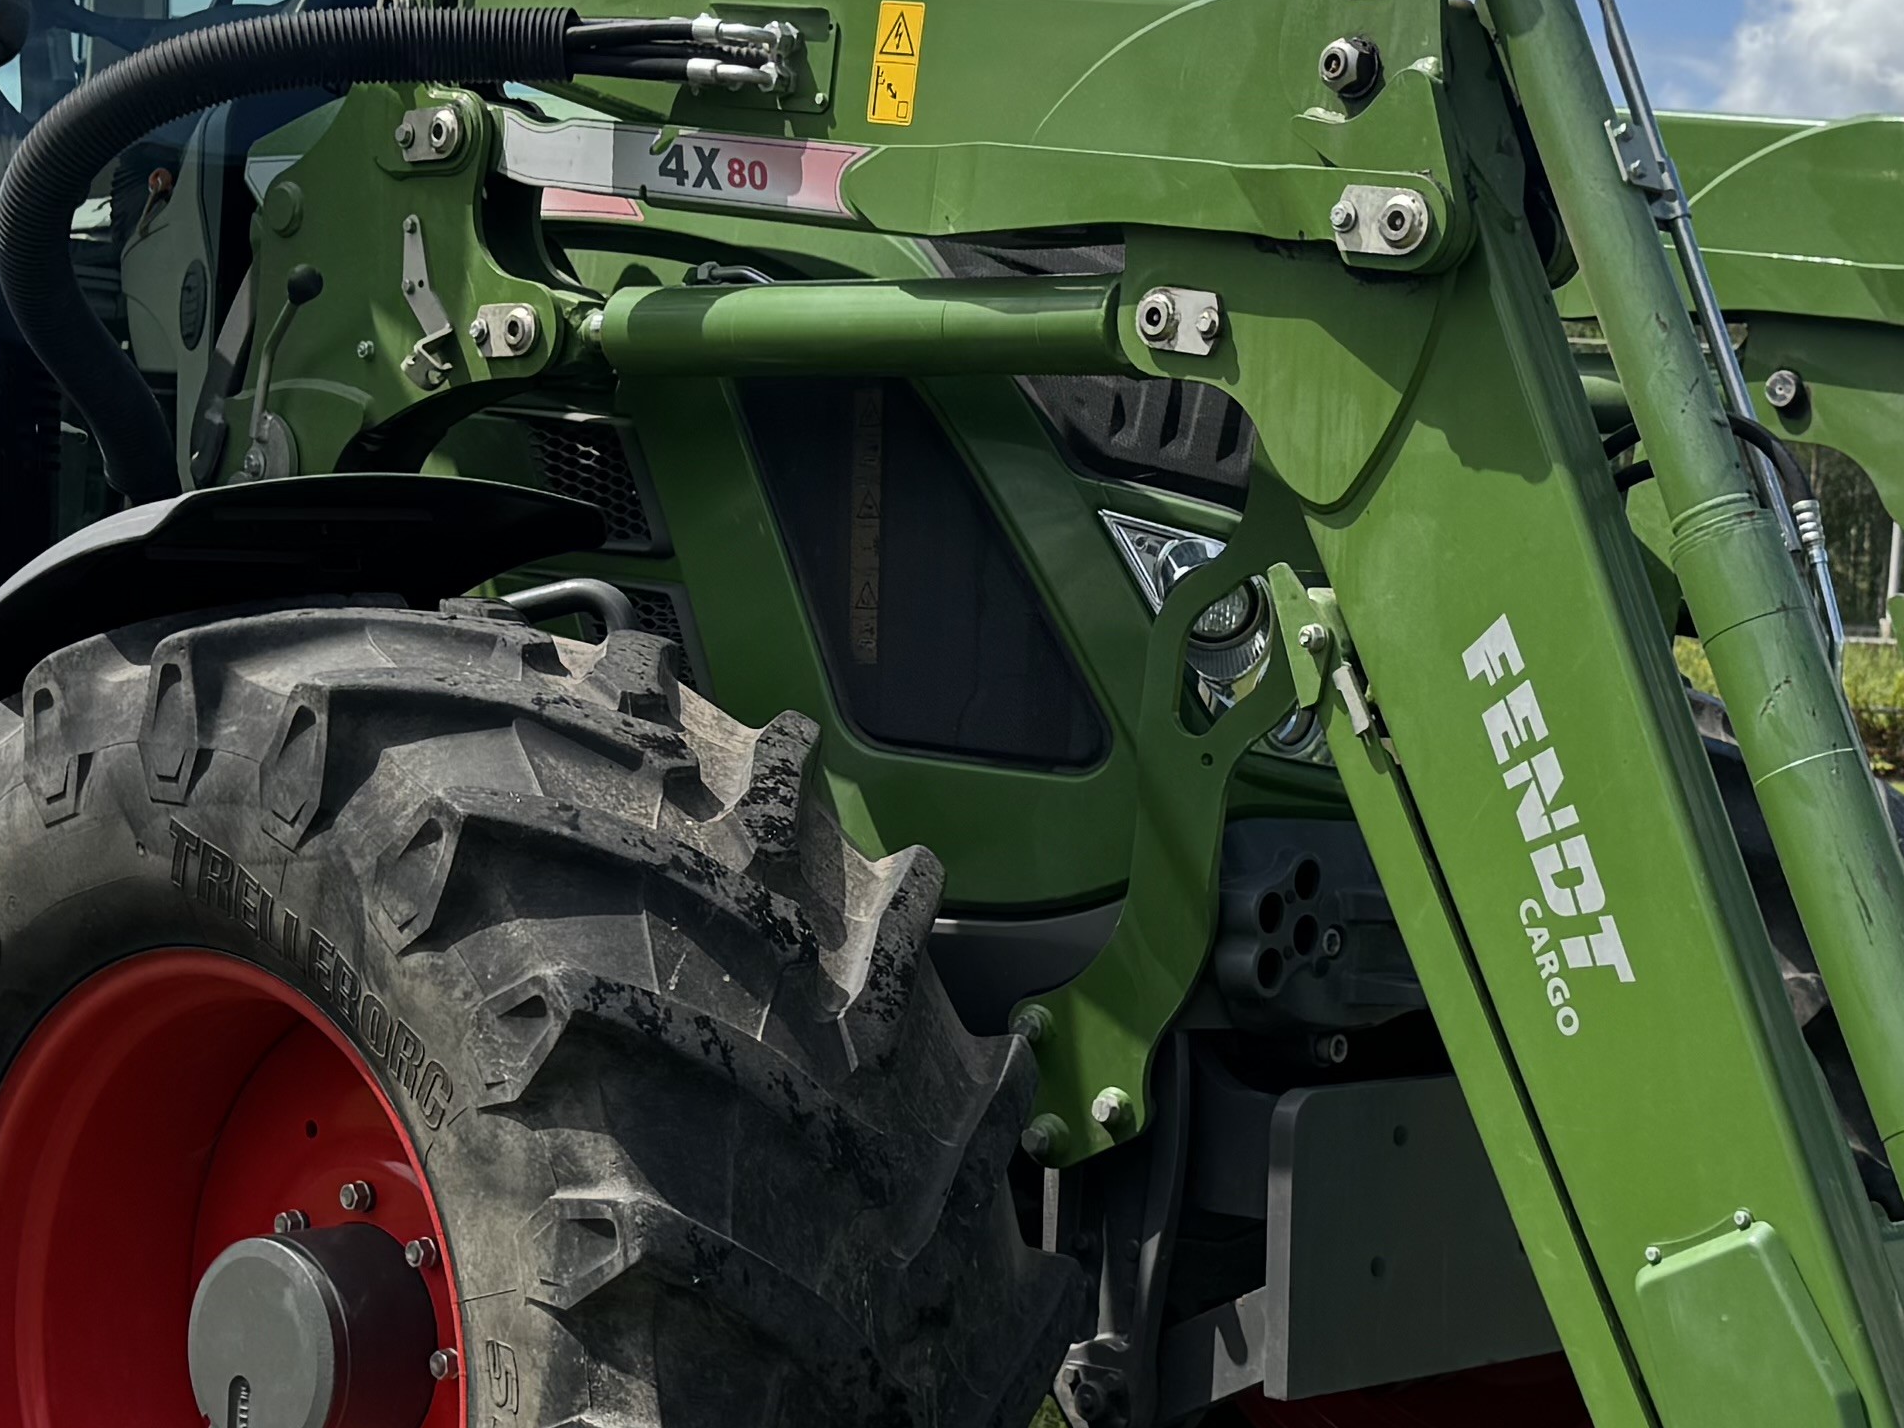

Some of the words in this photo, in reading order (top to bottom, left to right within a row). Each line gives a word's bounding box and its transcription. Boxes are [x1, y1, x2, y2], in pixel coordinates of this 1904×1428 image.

[1461, 613, 1637, 984] FENDT
[169, 816, 455, 1131] TRELLEBORG
[1518, 898, 1581, 1038] CARGO
